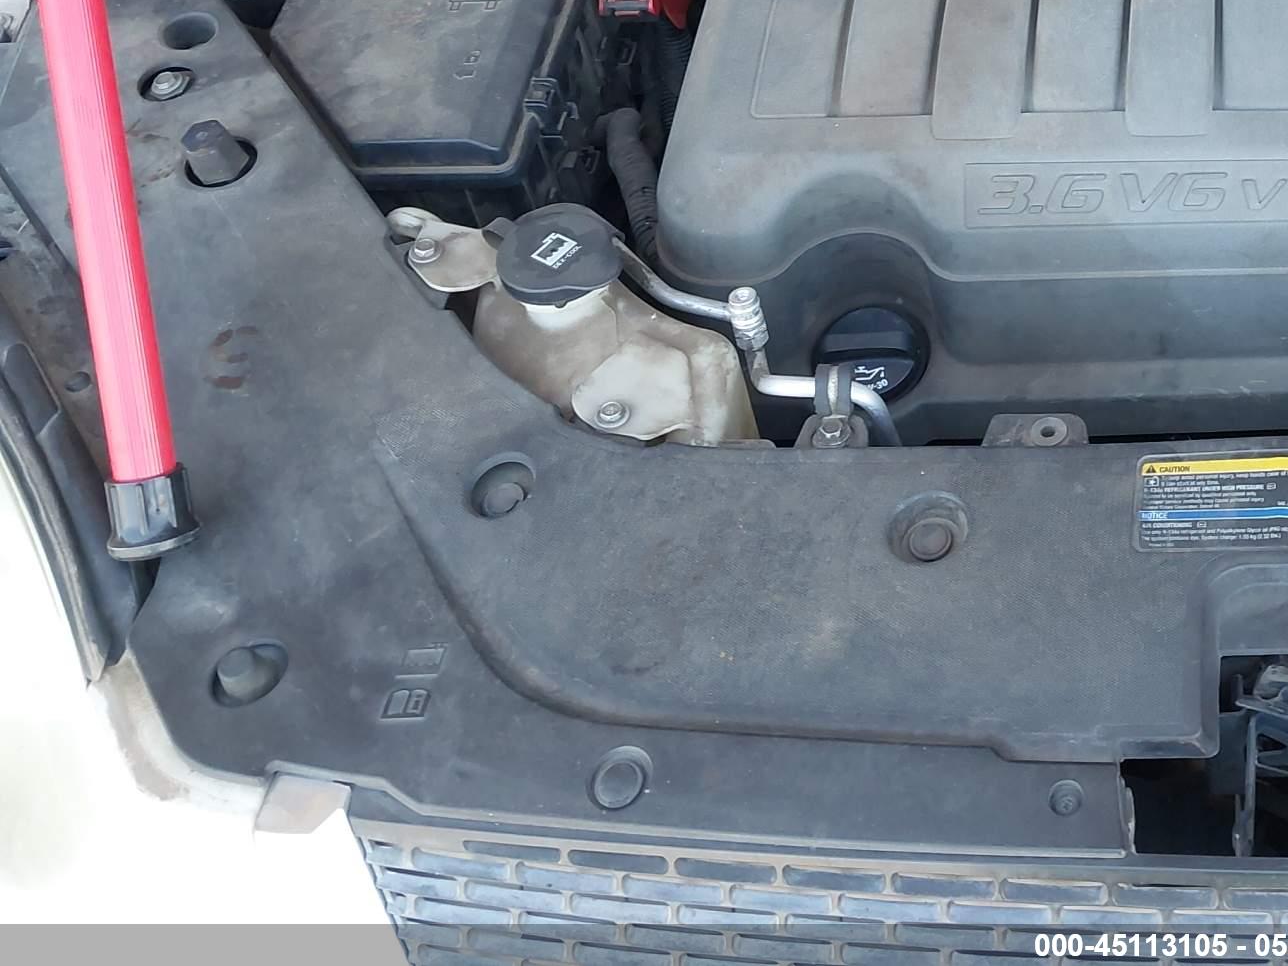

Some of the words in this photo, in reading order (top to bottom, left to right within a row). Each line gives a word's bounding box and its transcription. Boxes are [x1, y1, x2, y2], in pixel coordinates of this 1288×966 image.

[977, 173, 1107, 216] 3.6
[1119, 171, 1228, 213] V6
[552, 245, 583, 269] DEX-COOL
